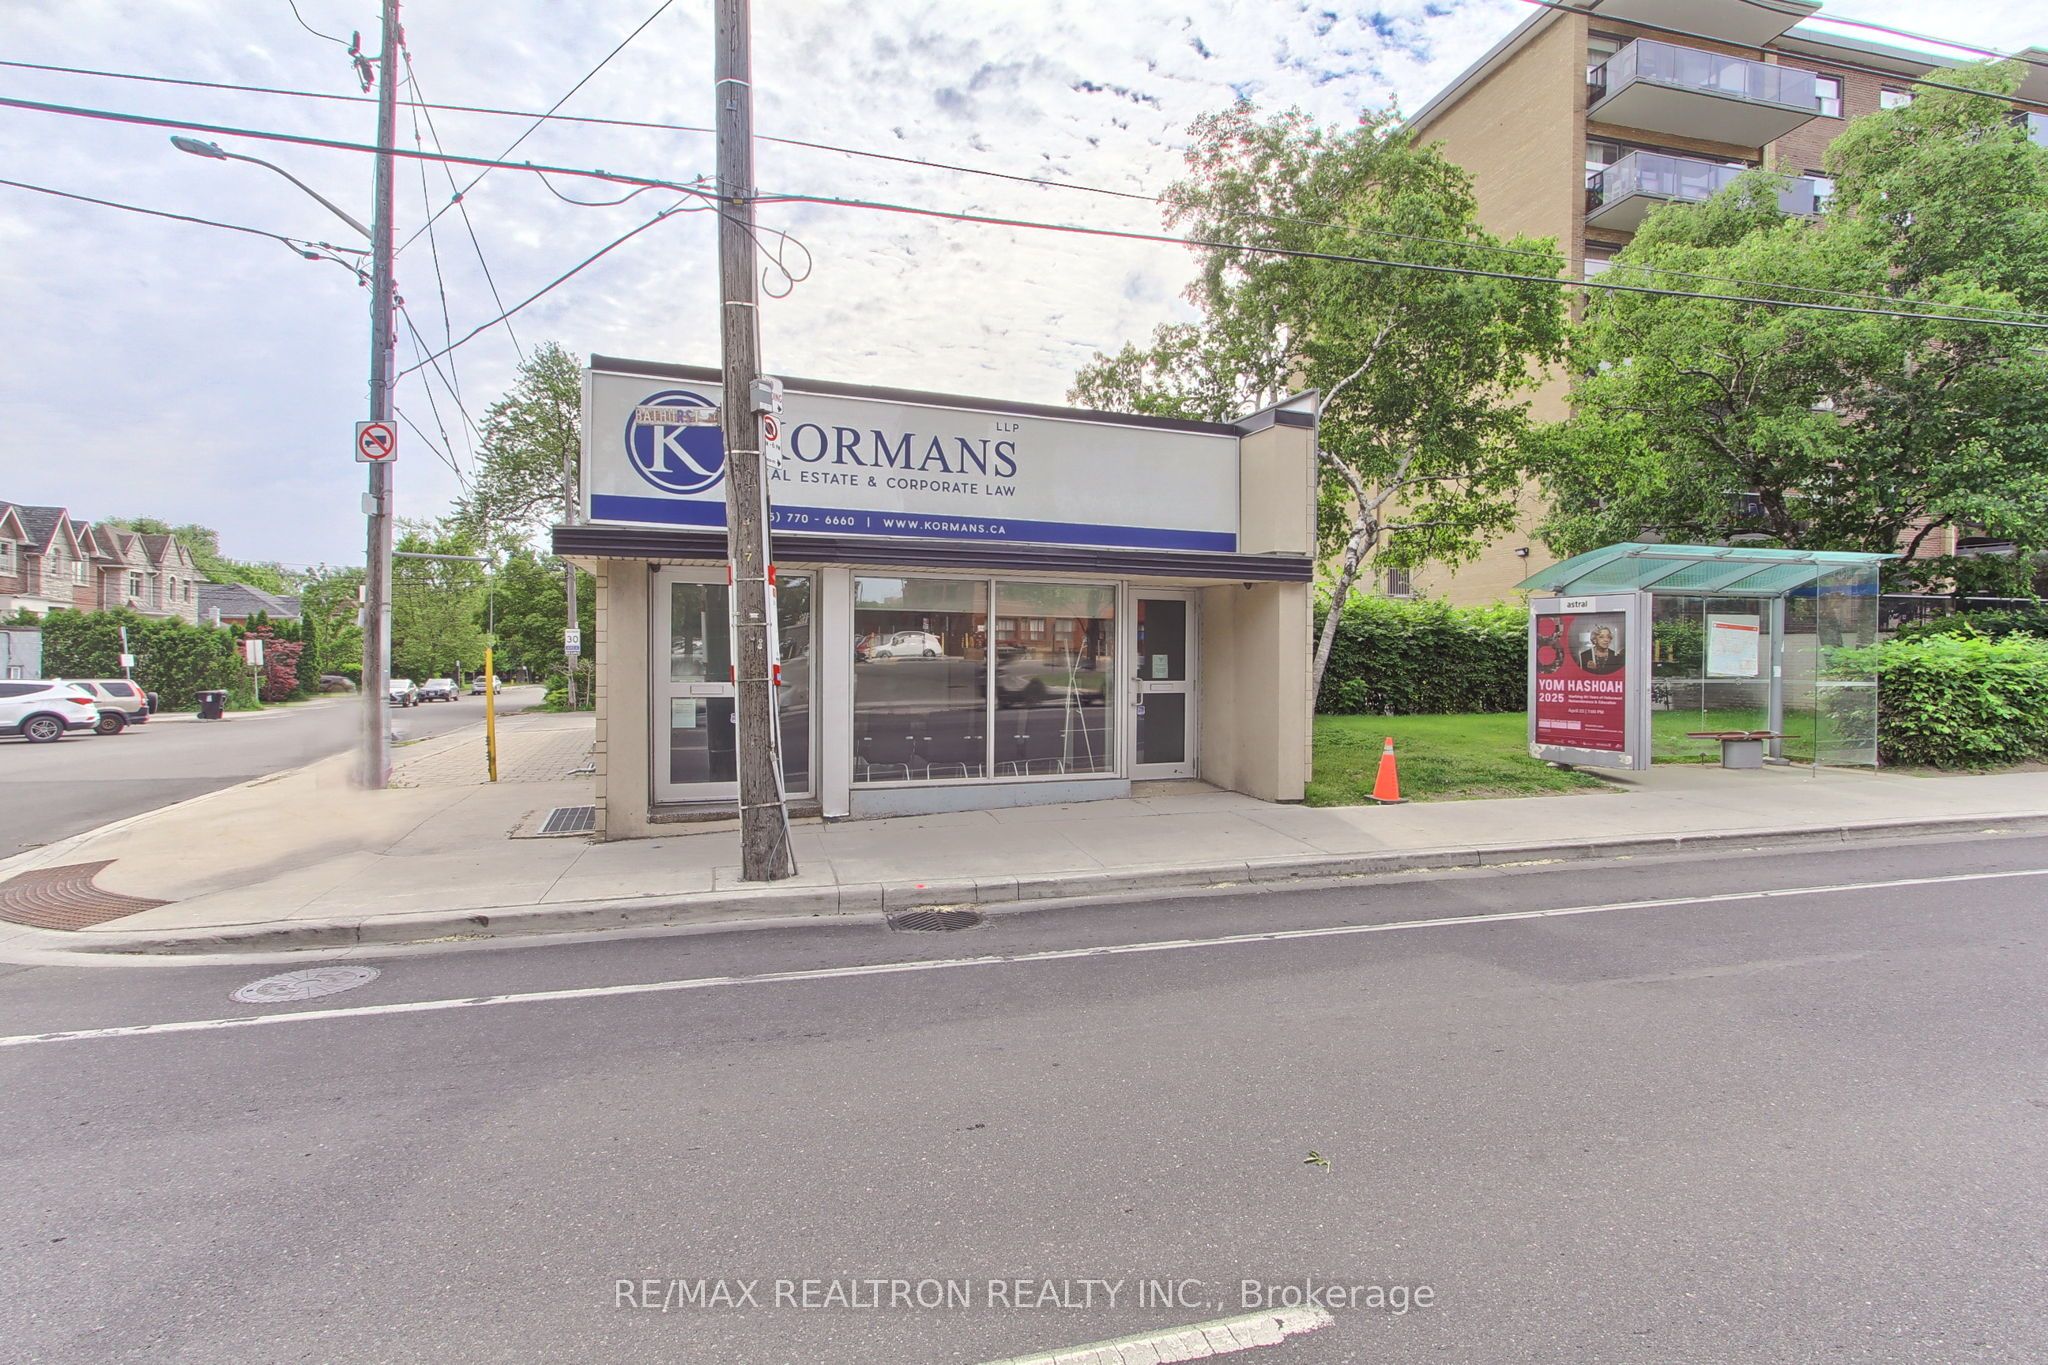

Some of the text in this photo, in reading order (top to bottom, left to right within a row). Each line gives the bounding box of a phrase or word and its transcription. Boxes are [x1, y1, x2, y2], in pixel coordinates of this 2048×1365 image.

[996, 422, 1020, 432] LLP
[781, 421, 1018, 478] ORMANS
[770, 468, 1016, 497] AL ESTATE & CORPORATE LAW
[786, 513, 809, 524] 770
[824, 515, 855, 526] 6660
[883, 518, 1006, 534] WWW.KORMANS.CA
[1566, 600, 1588, 608] astral
[566, 635, 579, 643] 30
[1538, 679, 1623, 693] YOM HASHOAH
[1538, 692, 1565, 703] 2025
